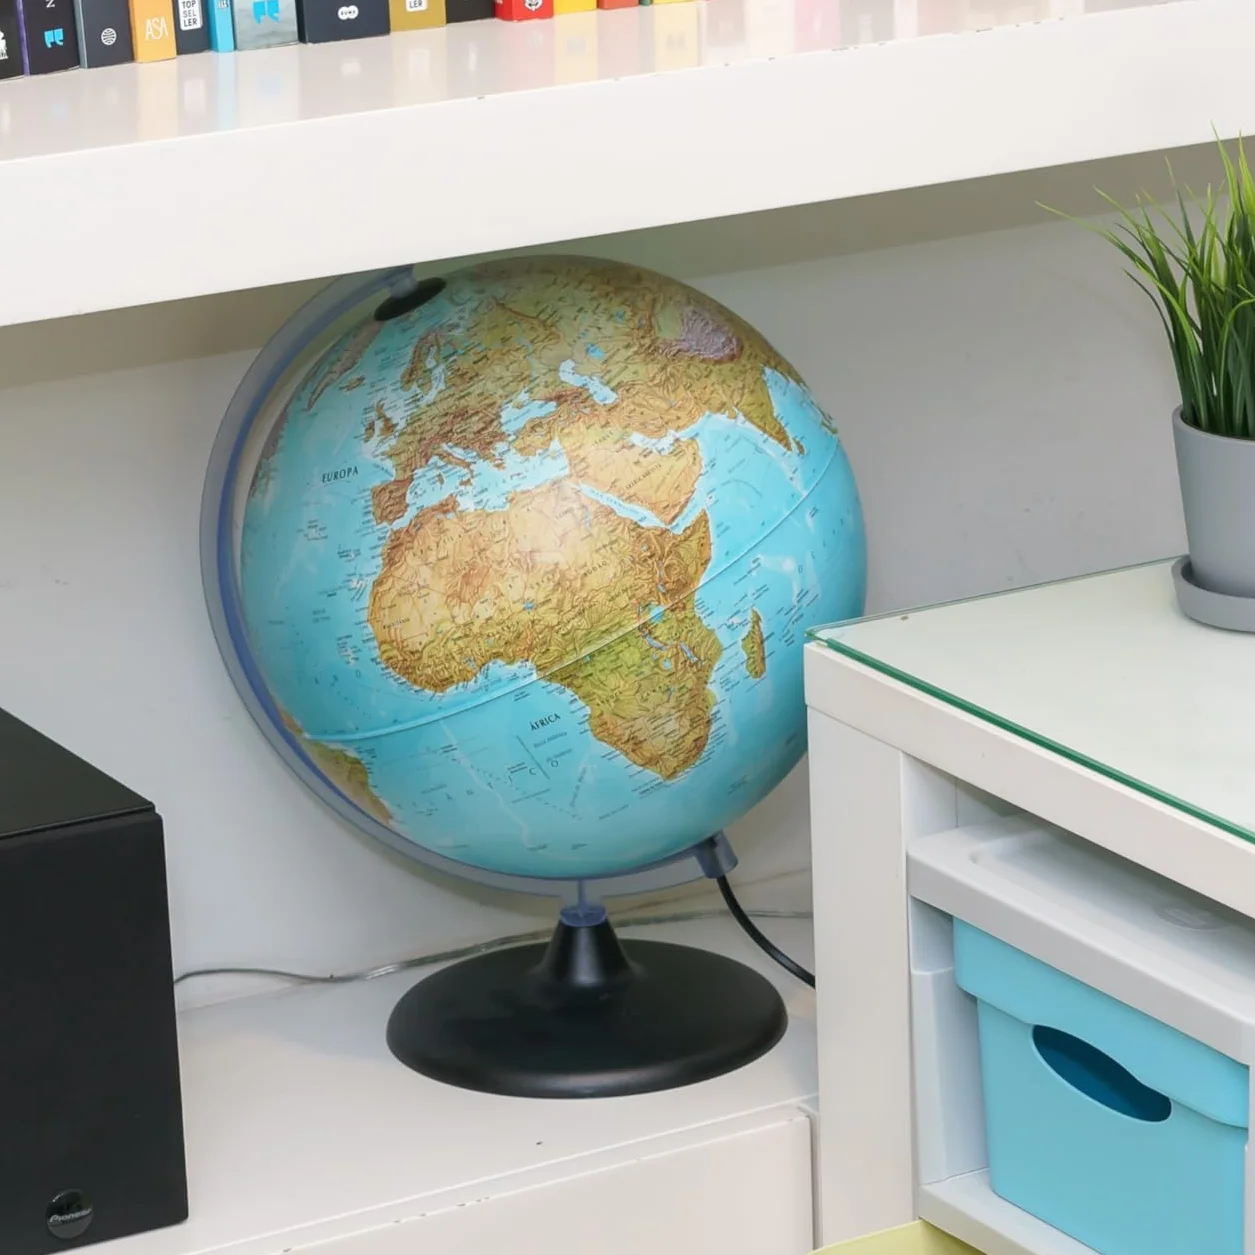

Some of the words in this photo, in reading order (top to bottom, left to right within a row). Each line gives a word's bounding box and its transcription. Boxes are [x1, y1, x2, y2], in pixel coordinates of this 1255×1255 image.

[182, 0, 197, 9] TOP
[183, 10, 197, 18] SEL
[145, 16, 169, 40] ASA
[183, 18, 198, 27] LER
[321, 466, 359, 483] EUROPA
[529, 712, 561, 731] ÁFRICA
